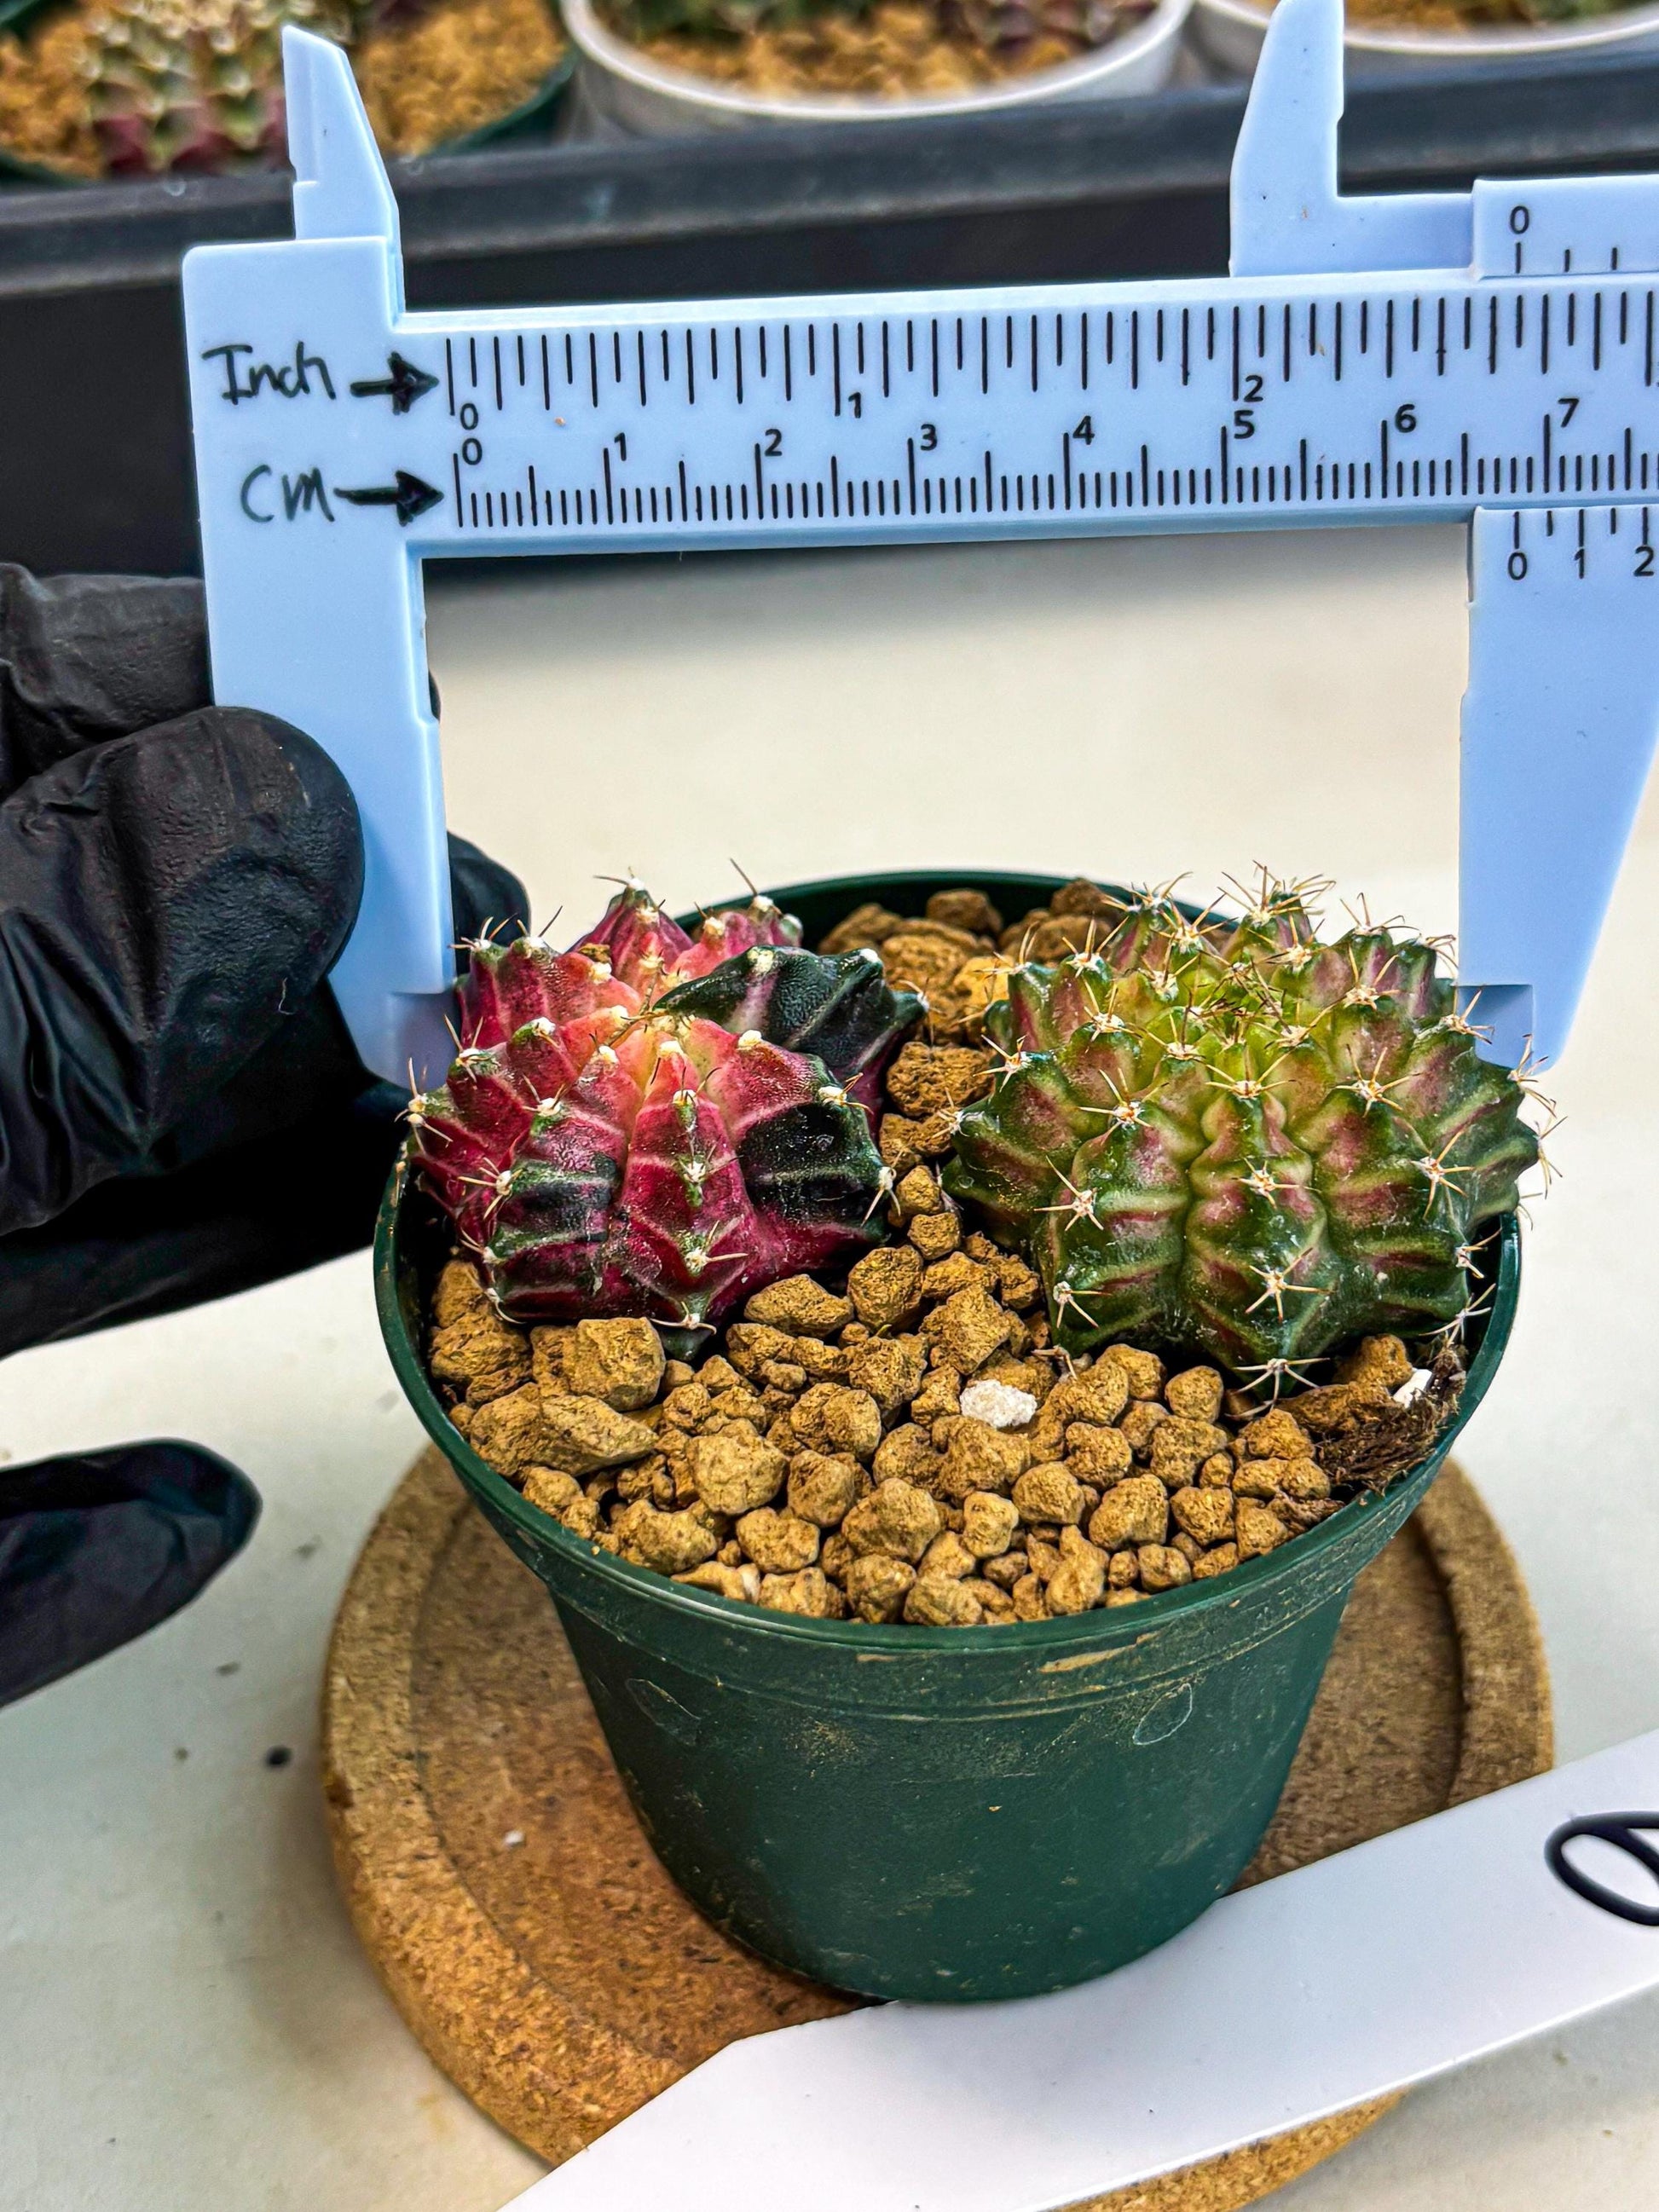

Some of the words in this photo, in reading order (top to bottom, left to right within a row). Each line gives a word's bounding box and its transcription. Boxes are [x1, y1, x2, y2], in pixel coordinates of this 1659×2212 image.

[1509, 205, 1530, 235] 0
[200, 340, 338, 407] Inch
[459, 401, 480, 431] 0
[847, 391, 863, 419] 1
[1242, 373, 1265, 403] 2
[460, 436, 483, 467] 0
[613, 432, 628, 461] 1
[763, 427, 783, 458] 2
[919, 423, 939, 452] 3
[1072, 414, 1096, 446] 4
[1233, 409, 1257, 440] 5
[1393, 403, 1418, 434] 6
[1557, 396, 1581, 429] 7
[1506, 551, 1529, 581] 0
[1573, 548, 1586, 580] 1
[1632, 545, 1656, 578] 2
